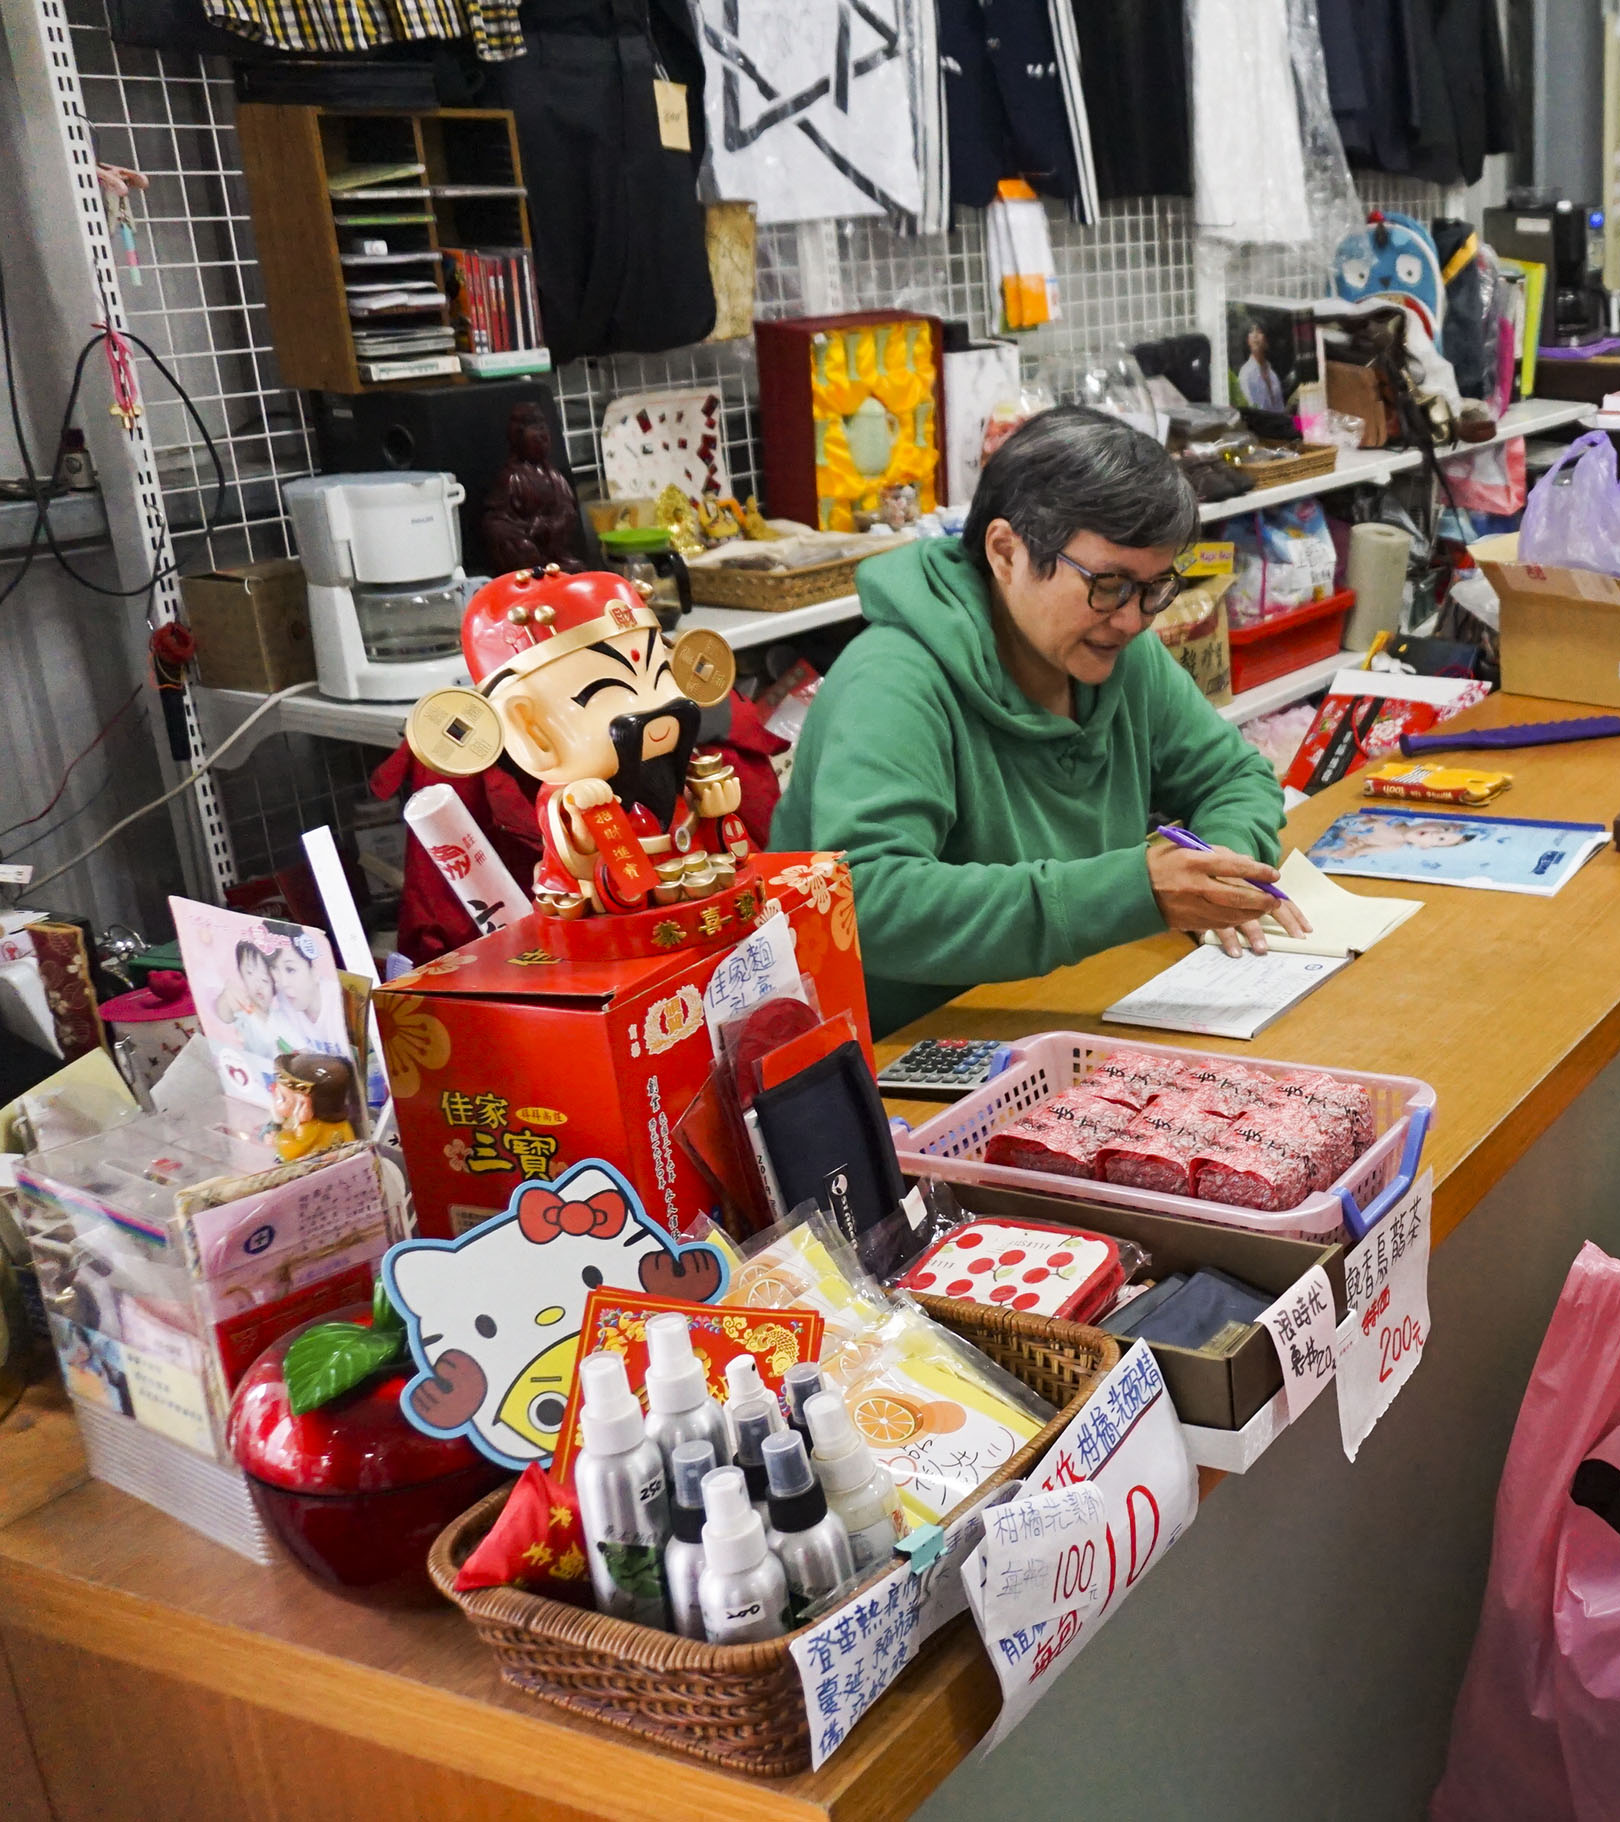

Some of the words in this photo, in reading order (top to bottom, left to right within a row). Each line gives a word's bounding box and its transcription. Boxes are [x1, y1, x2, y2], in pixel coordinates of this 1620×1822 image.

[595, 810, 640, 880] 招財進寶
[441, 1090, 509, 1129] 佳家
[467, 1128, 557, 1182] 三寶
[756, 1154, 771, 1197] 2019
